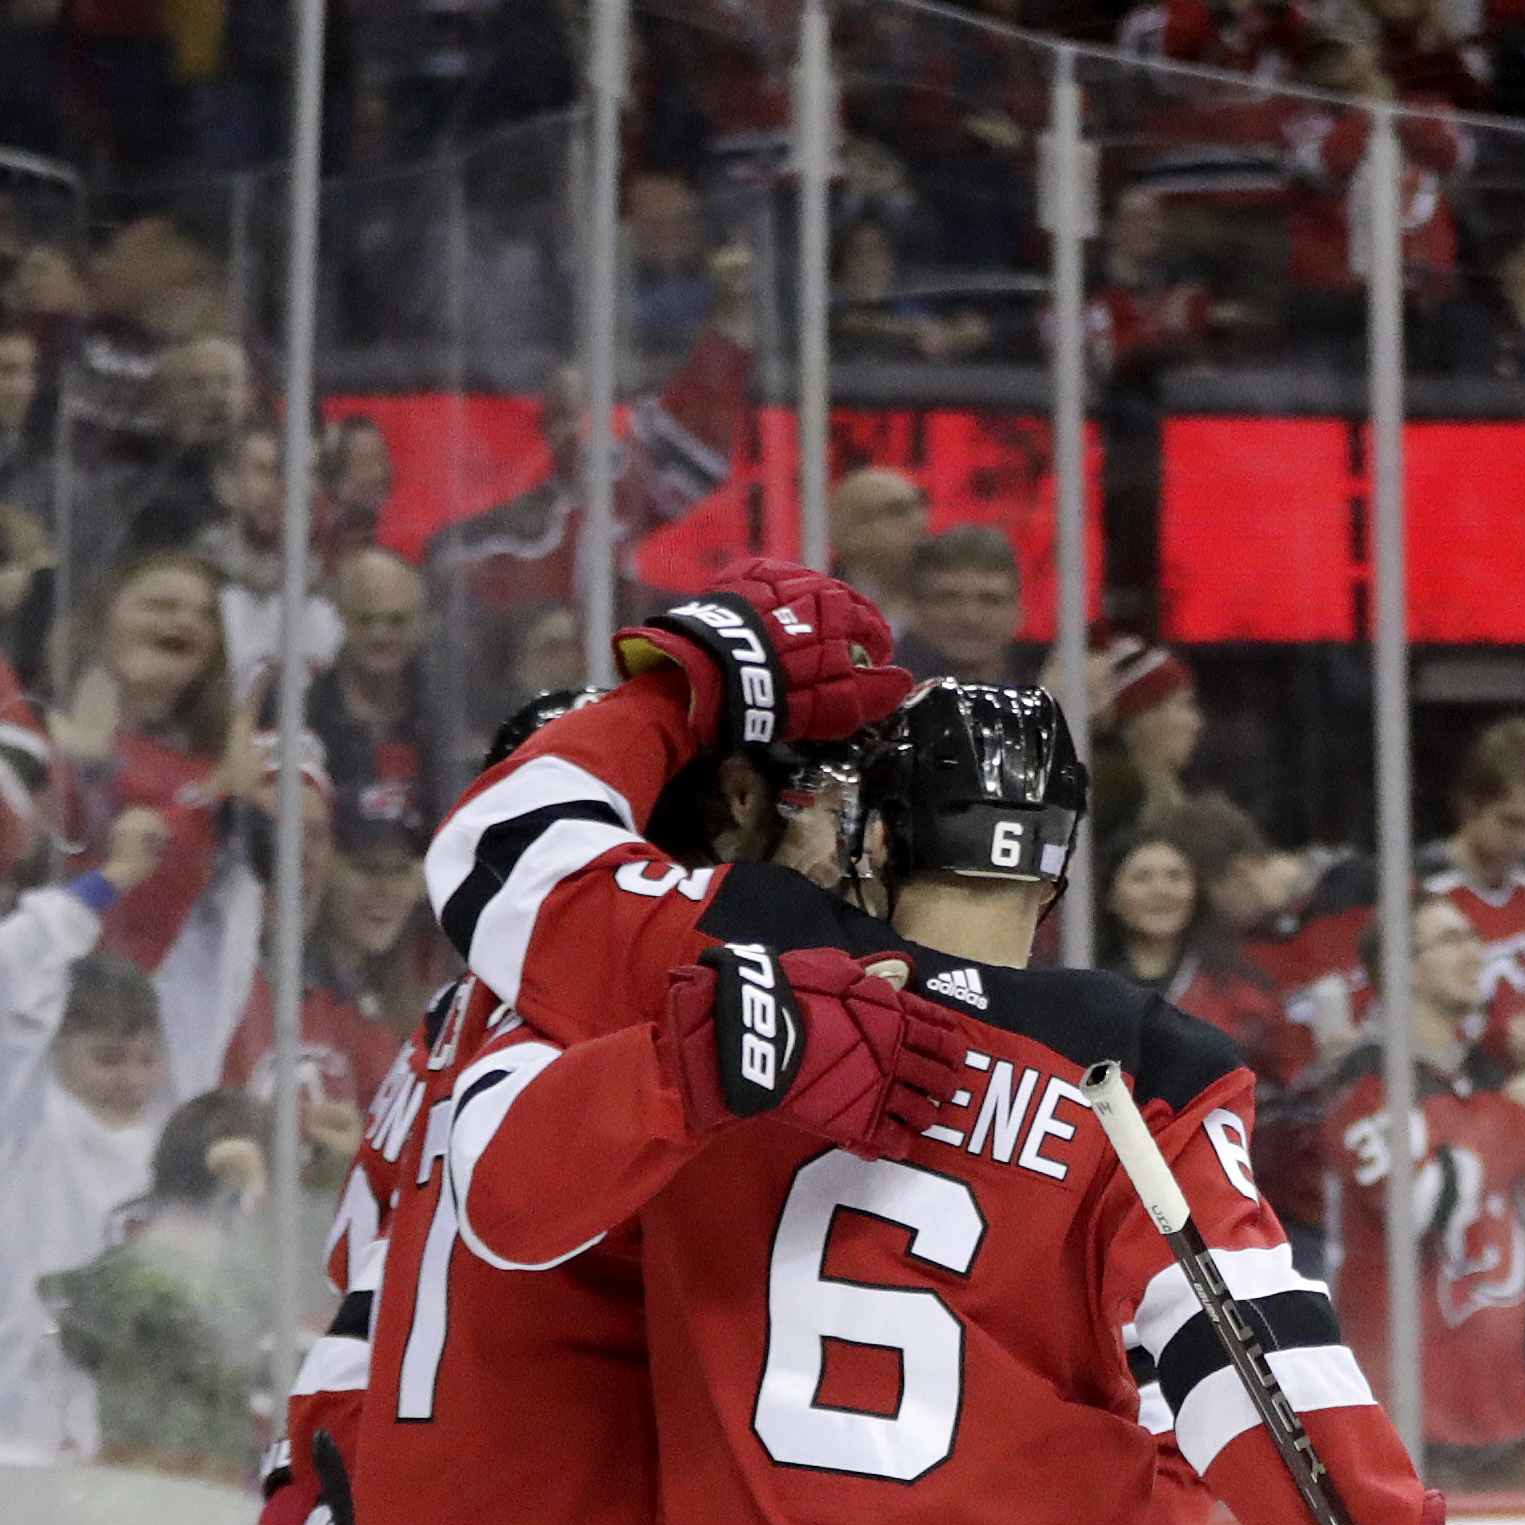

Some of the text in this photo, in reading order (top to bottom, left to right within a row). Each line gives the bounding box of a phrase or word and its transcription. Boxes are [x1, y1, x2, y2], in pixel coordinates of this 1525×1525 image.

[990, 820, 1025, 868] 6
[926, 977, 990, 1011] adidas
[751, 1146, 991, 1488] 6
